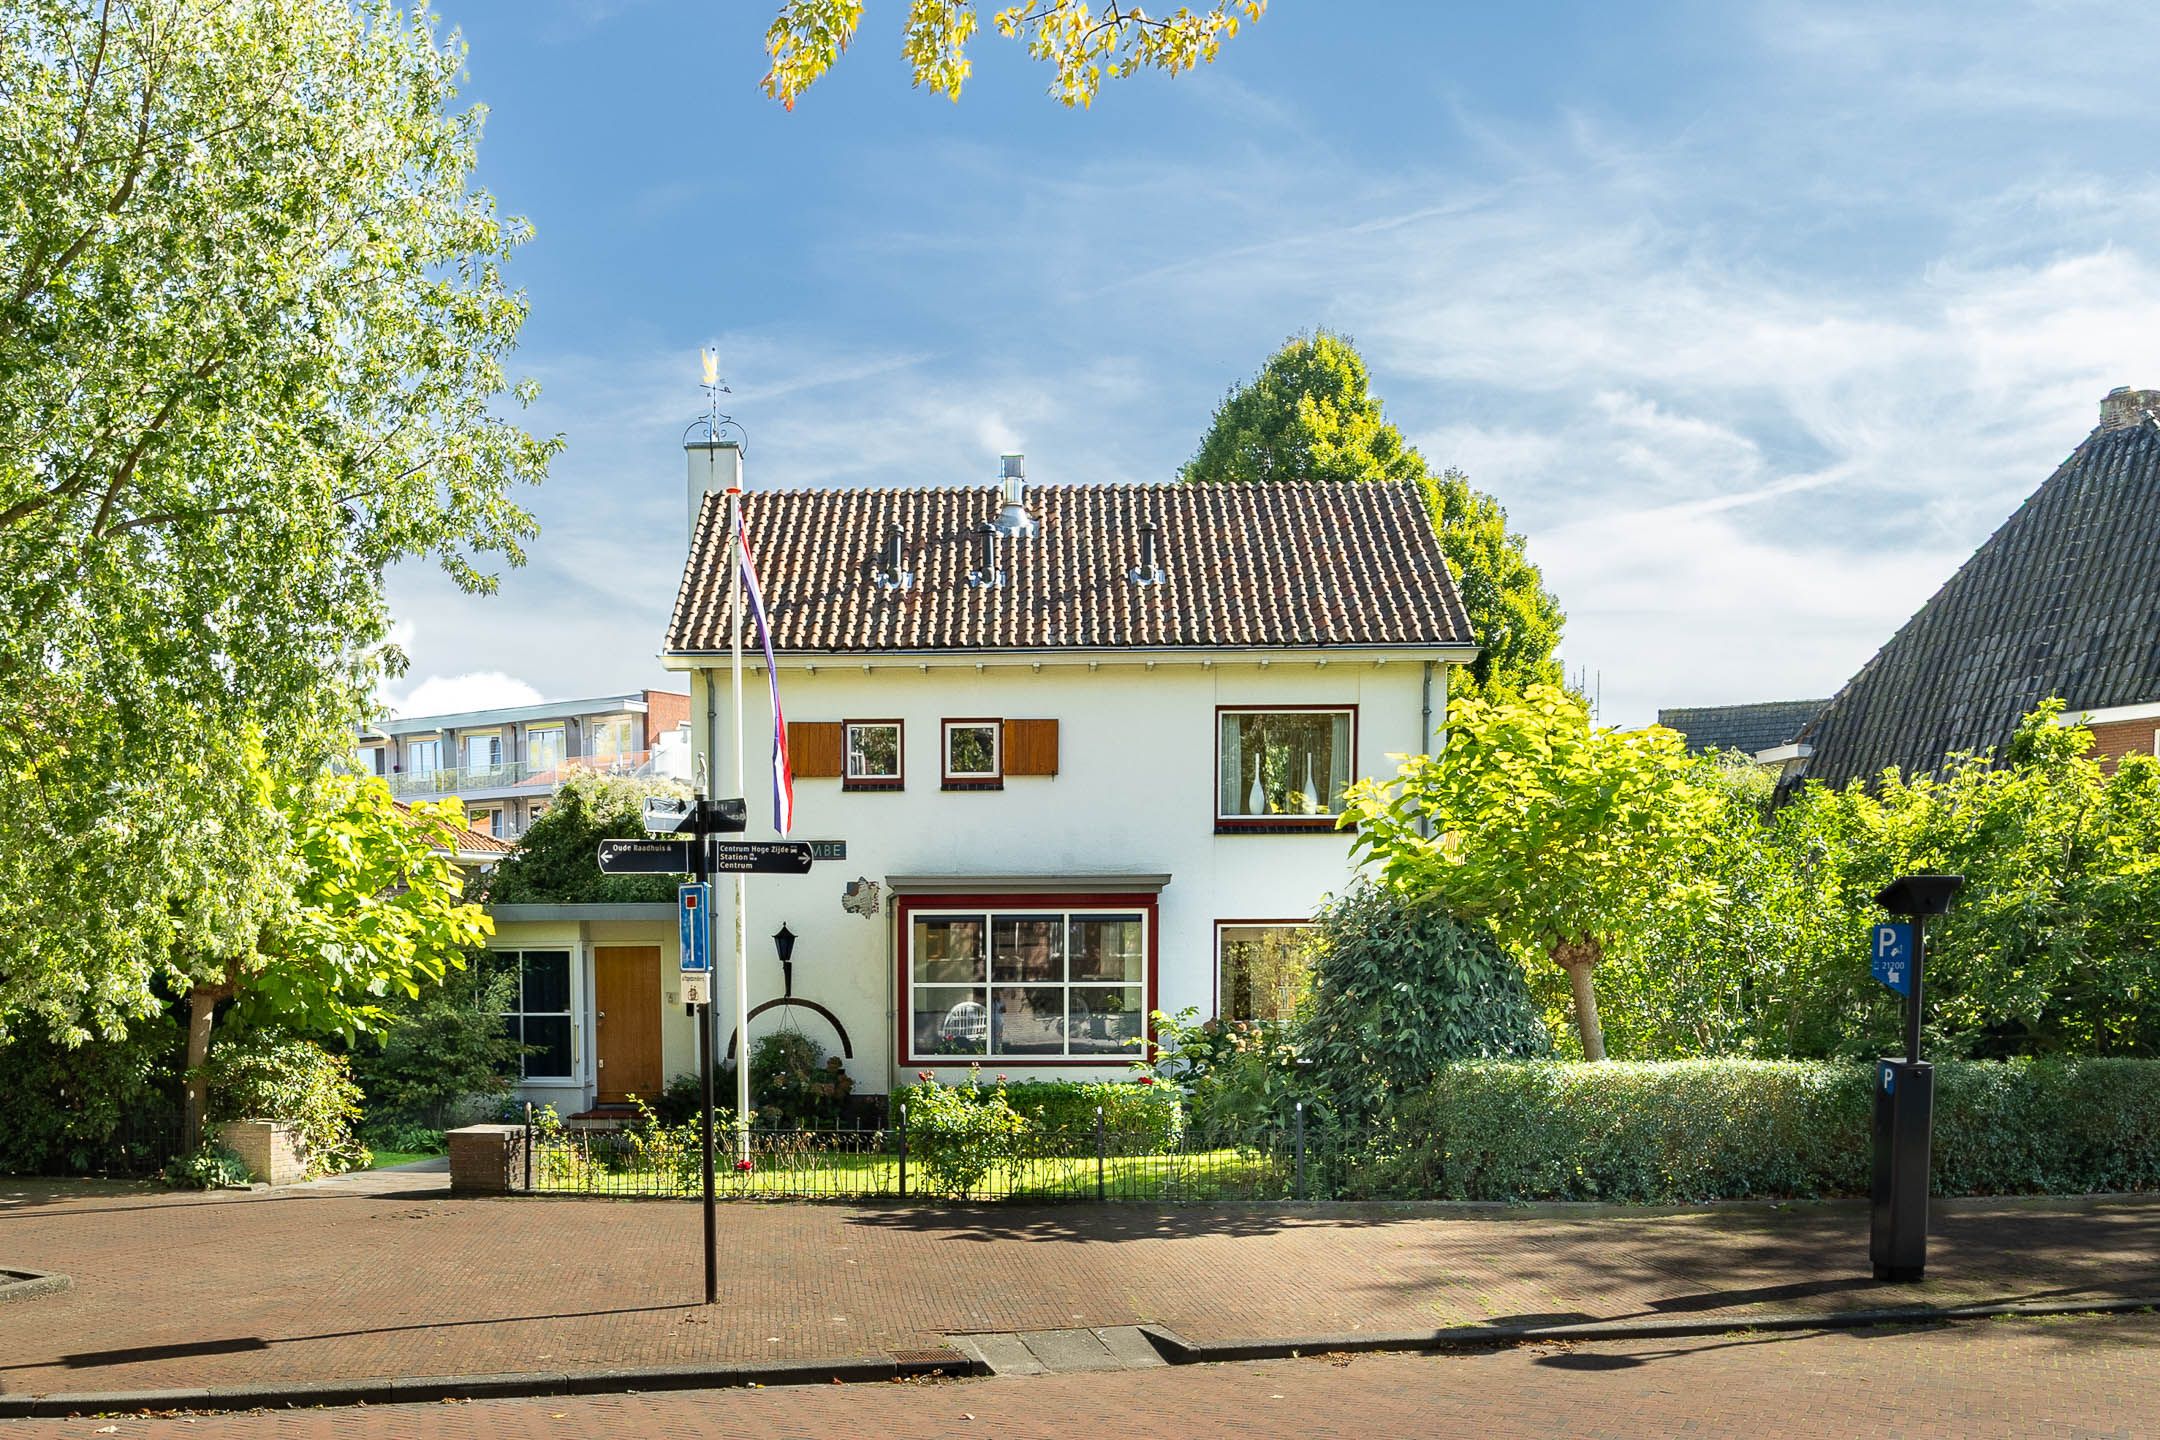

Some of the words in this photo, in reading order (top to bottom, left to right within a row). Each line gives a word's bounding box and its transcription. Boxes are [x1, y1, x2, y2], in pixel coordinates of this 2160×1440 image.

[612, 844, 632, 852] Oude
[633, 844, 666, 852] Raadhuis
[719, 845, 750, 853] Centrum
[751, 845, 769, 854] Hoge
[771, 845, 789, 855] Zijde
[719, 853, 748, 861] Station
[719, 861, 753, 869] Centrum
[1879, 927, 1897, 957] P
[1884, 1068, 1893, 1089] P
